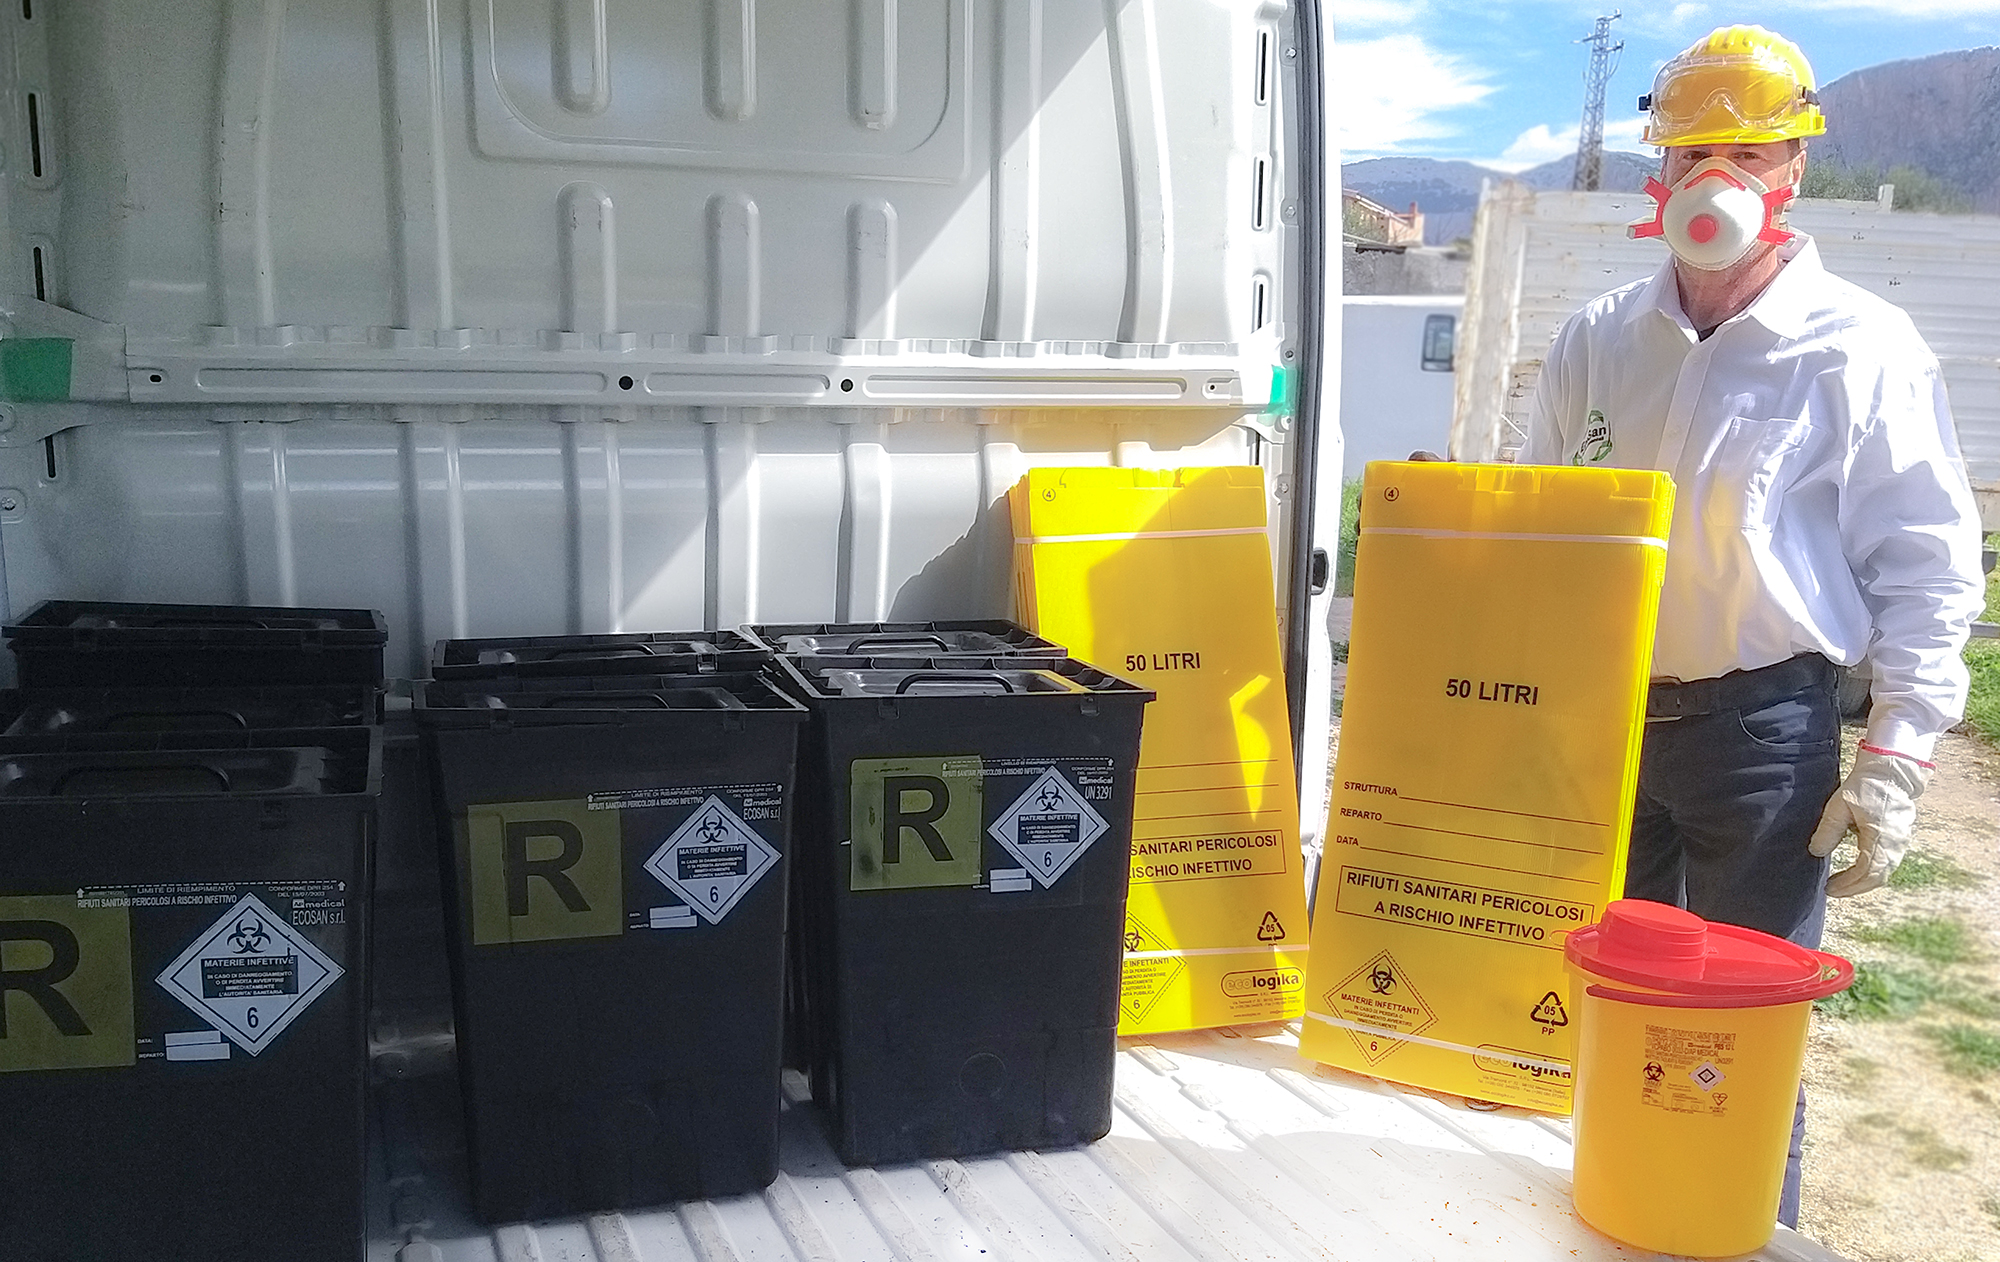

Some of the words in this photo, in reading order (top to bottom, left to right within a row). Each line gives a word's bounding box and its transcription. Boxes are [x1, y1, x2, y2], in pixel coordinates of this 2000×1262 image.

[1126, 655, 1147, 672] 50
[1153, 652, 1201, 671] LITRI
[1446, 678, 1472, 698] 50
[1479, 681, 1539, 706] LITRI
[977, 768, 1002, 776] PERICOLOSI
[1085, 786, 1095, 800] UN
[1096, 786, 1112, 800] 3291
[1344, 781, 1398, 796] STRUTTURA
[588, 802, 605, 811] RIFIUTI
[605, 801, 627, 810] SANITARI
[628, 800, 656, 808] PERICOLOSI
[661, 798, 680, 806] RISCHIO
[680, 797, 704, 805] INFETTIVO
[753, 797, 781, 806] medical
[744, 808, 770, 820] ECOSAN
[882, 776, 954, 864] R
[1340, 807, 1382, 822] REPARTO
[1130, 840, 1192, 856] SANITARI
[1197, 835, 1277, 851] PERICOLOSI
[1336, 835, 1359, 847] DATA
[710, 845, 745, 853] INFETTIVE
[1045, 851, 1052, 867] 6
[506, 820, 592, 916] R
[1128, 864, 1178, 879] ISCHIO
[1183, 859, 1252, 875] INFETTIVO
[78, 899, 100, 909] RIFIUTI
[101, 897, 131, 908] SANITARI
[132, 897, 171, 907] PERICOLOSI
[177, 896, 203, 905] RISCHIO
[204, 895, 238, 904] INFETTIVO
[710, 886, 719, 903] 6
[1347, 872, 1399, 892] RIFIUTI
[1403, 881, 1477, 905] SANITARI
[1482, 893, 1584, 922] PERICOLOSI
[305, 899, 345, 908] medical
[293, 910, 328, 926] ECOSAN
[1374, 900, 1385, 914] A
[1390, 903, 1455, 926] RISCHIO
[1459, 915, 1545, 941] INFETTIVO
[1266, 924, 1275, 933] 05
[204, 959, 245, 967] MATERIE
[248, 957, 294, 965] INFETTIVE
[1130, 958, 1170, 967] INFETTANTI
[0, 919, 93, 1040] R
[1226, 971, 1299, 991] ecologika
[1134, 1000, 1141, 1010] 6
[1341, 993, 1374, 1007] MATERIE
[1375, 1000, 1420, 1015] INFETTANTI
[1544, 1004, 1556, 1016] 05
[247, 1007, 259, 1029] 6
[1541, 1026, 1556, 1037] PP
[1370, 1041, 1378, 1052] 6
